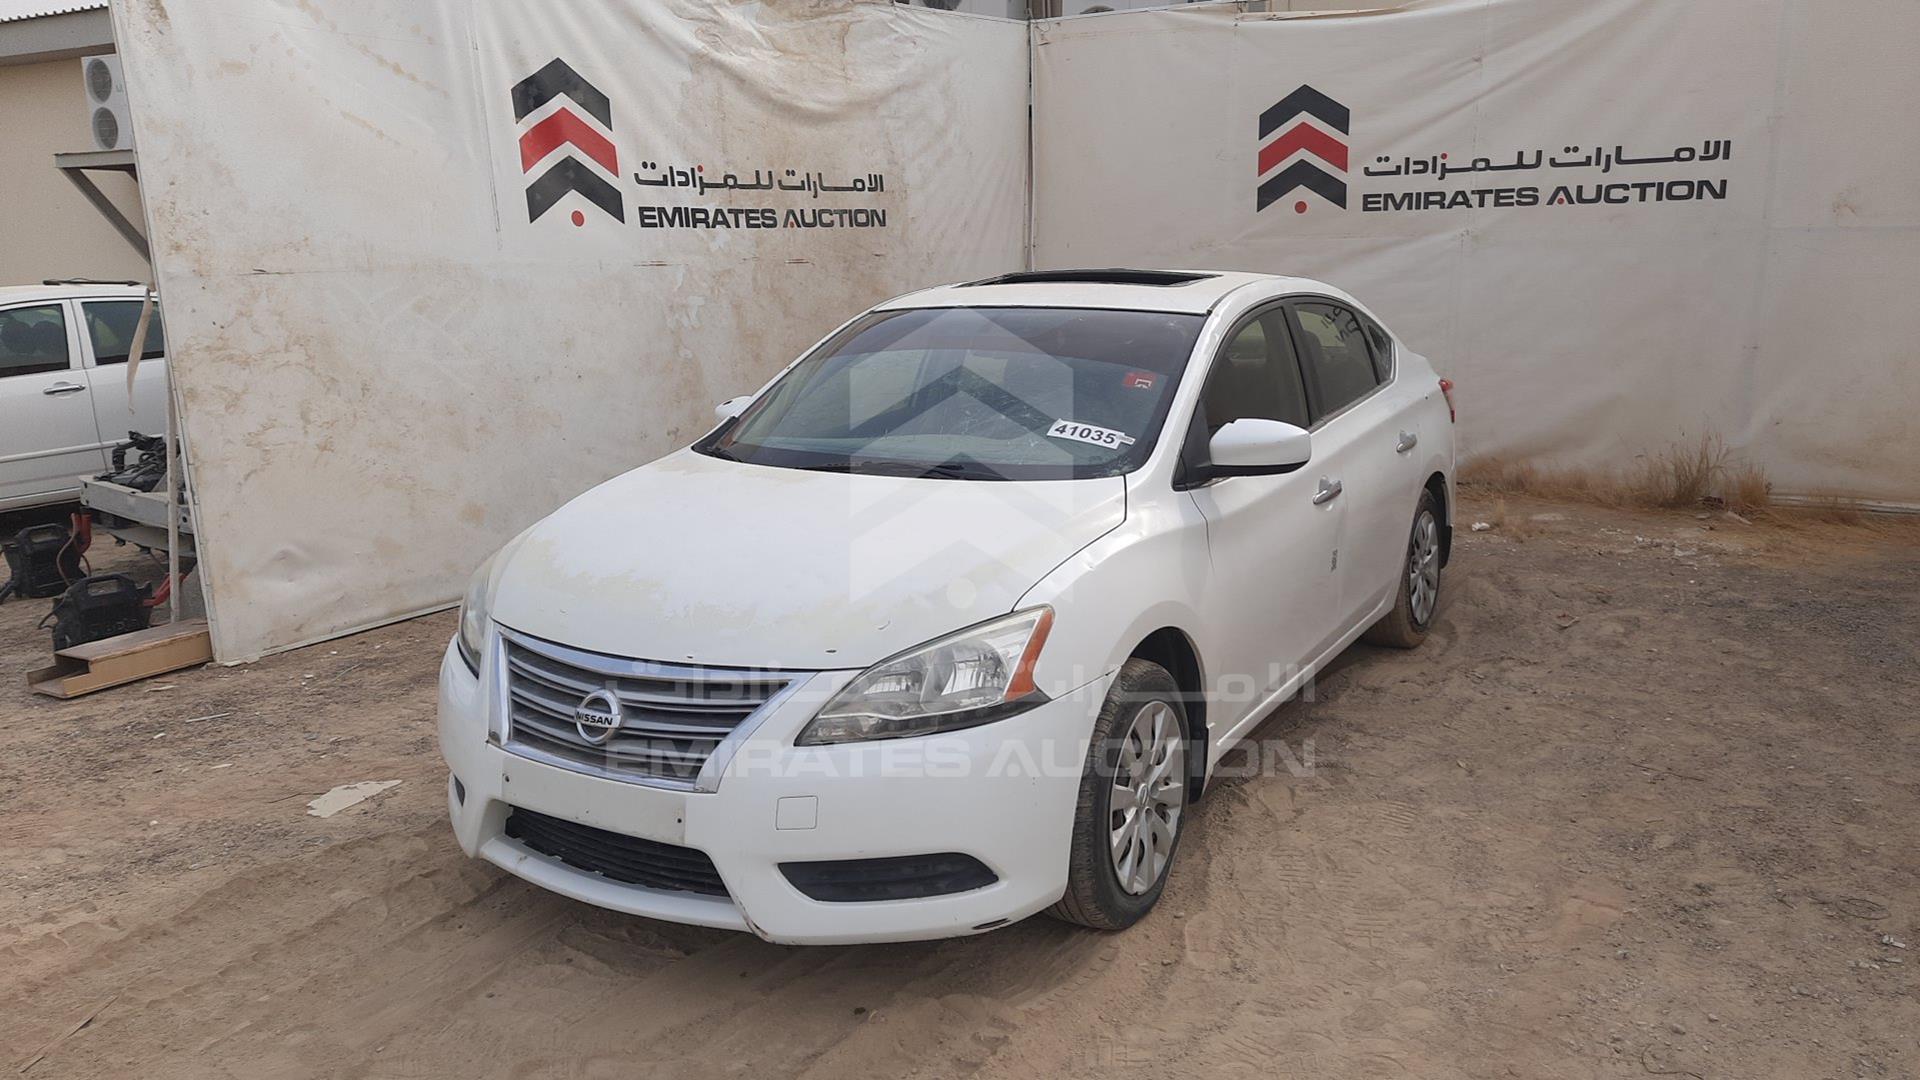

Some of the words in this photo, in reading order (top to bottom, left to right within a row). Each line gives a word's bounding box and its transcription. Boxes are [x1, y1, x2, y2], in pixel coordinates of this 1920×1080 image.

[1364, 149, 1543, 181] للمزادات
[1549, 140, 1732, 174] الامارات
[634, 161, 774, 195] للمزادات
[778, 169, 885, 198] الامارات
[1362, 186, 1540, 212] EMIRATES
[1546, 179, 1728, 206] AUCTION
[639, 206, 777, 228] EMIRATES
[783, 208, 887, 229] AUCTION
[1055, 423, 1117, 444] 41035
[576, 712, 613, 726] NISSAN
